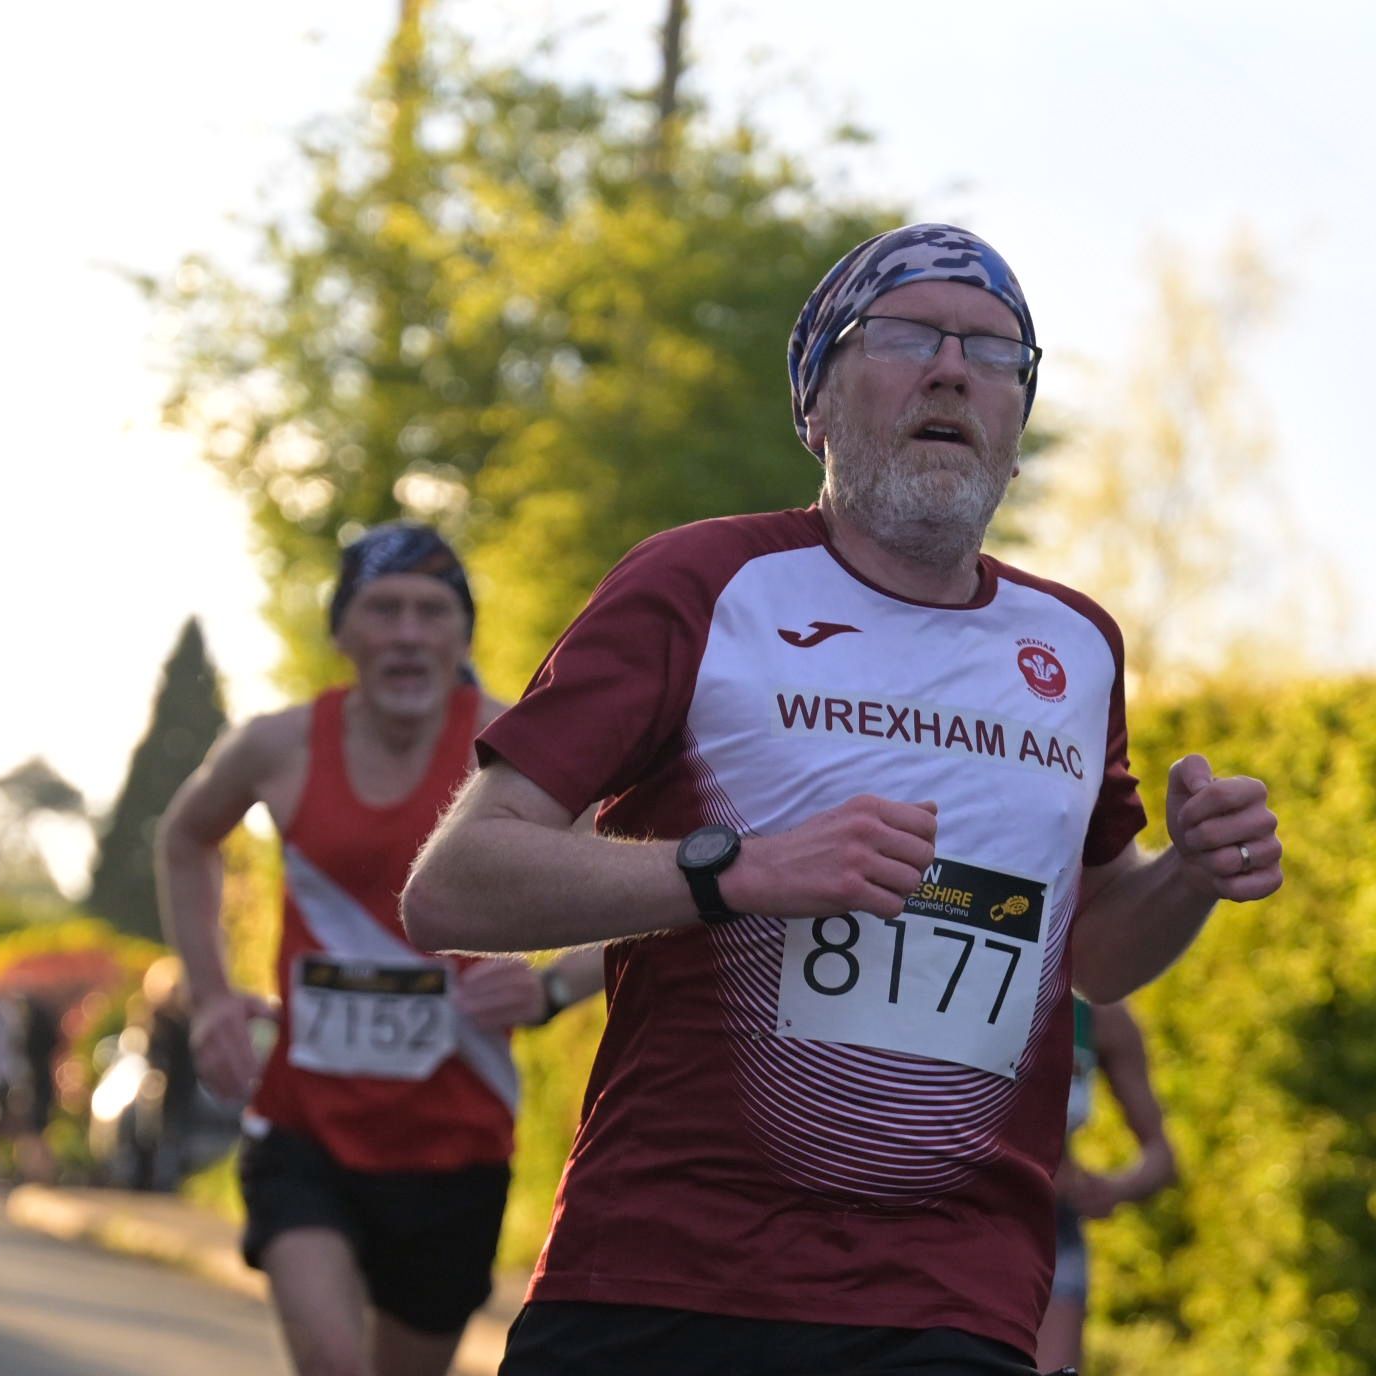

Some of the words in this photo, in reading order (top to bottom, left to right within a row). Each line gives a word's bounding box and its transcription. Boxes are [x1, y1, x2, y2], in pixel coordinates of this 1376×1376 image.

[776, 693, 1006, 758] WREXHAM
[1019, 729, 1084, 780] AAC
[908, 897, 943, 912] Gogledd
[944, 903, 969, 917] Cymru
[910, 882, 974, 908] SHIRE
[803, 911, 1022, 1025] 8177
[305, 992, 438, 1053] 7152
